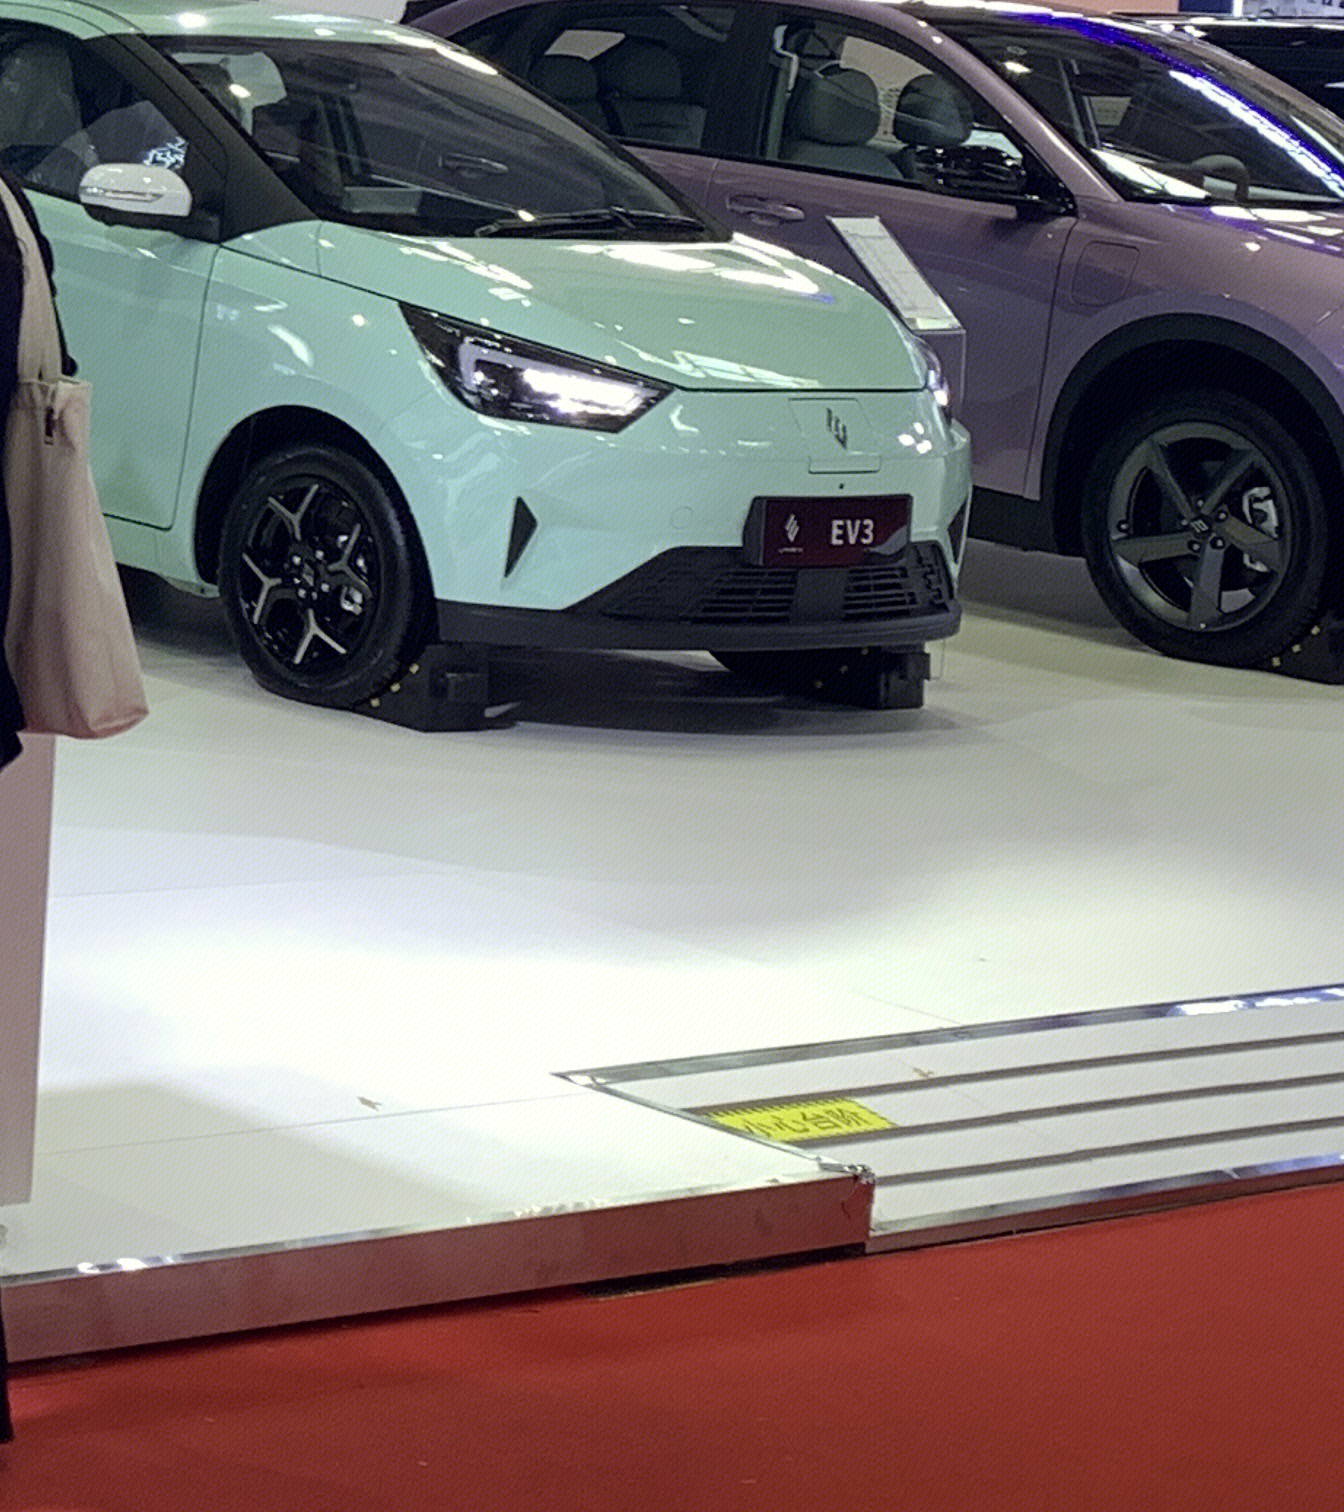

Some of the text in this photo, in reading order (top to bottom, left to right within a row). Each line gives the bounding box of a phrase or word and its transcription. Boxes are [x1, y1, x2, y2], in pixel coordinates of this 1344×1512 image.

[830, 518, 875, 546] EV3
[743, 1107, 870, 1138] 小心台阶
